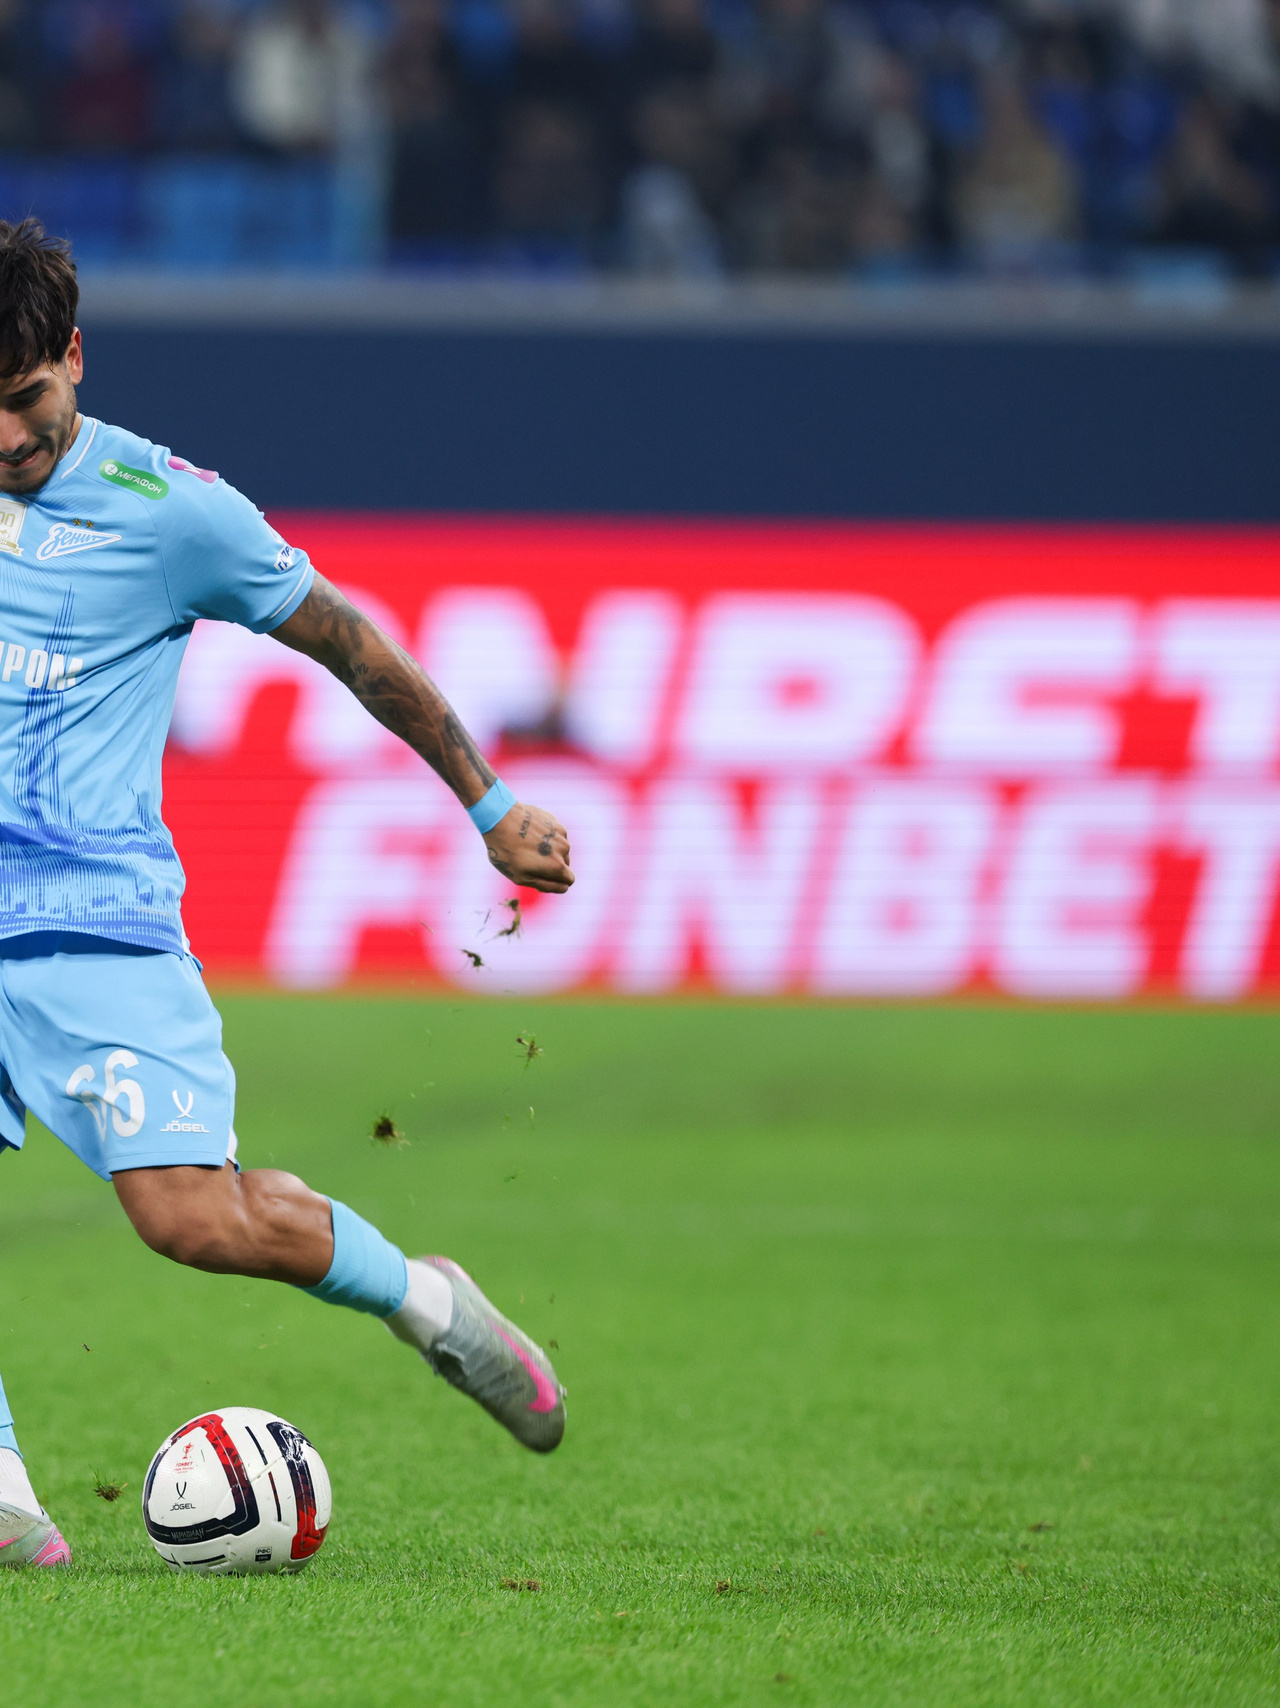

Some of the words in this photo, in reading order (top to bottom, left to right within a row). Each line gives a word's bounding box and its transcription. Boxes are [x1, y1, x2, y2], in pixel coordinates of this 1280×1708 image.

[117, 471, 163, 494] МЕГАФОН
[160, 1120, 210, 1134] JÖGEL
[170, 1502, 196, 1511] JÖGEL
